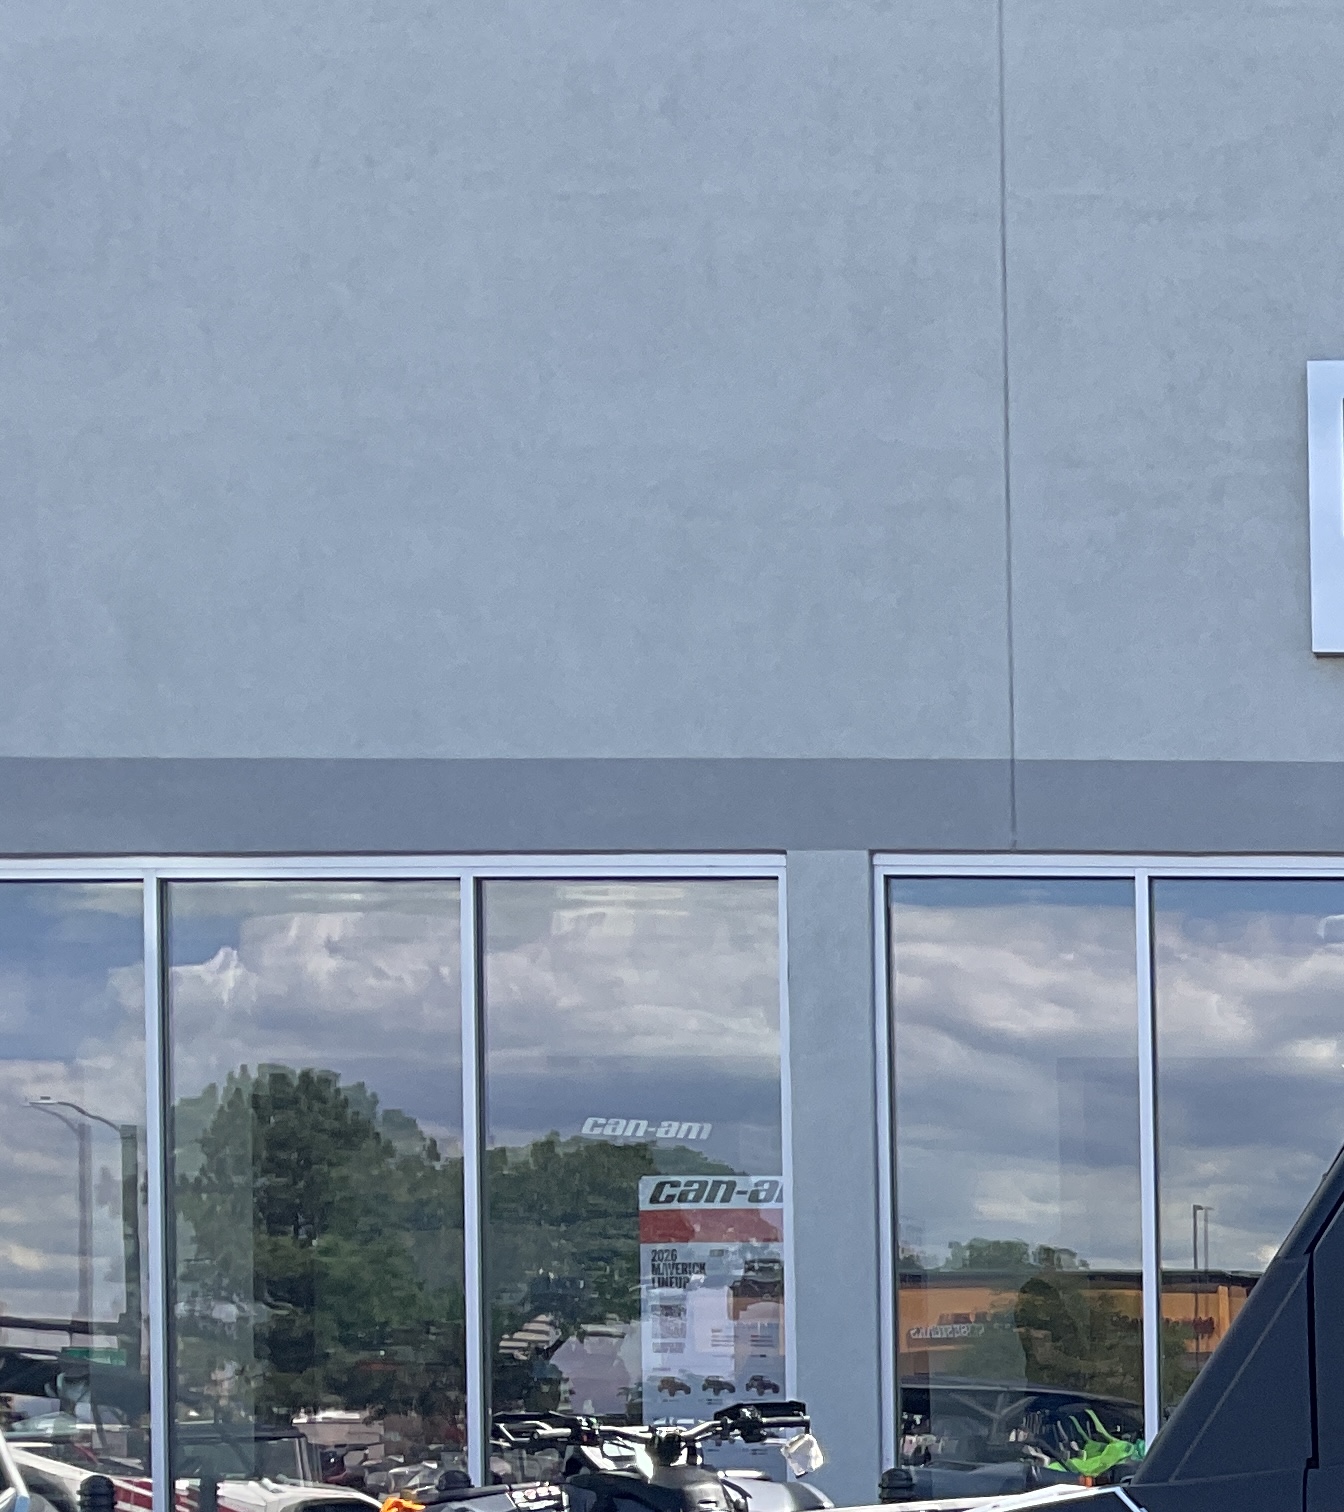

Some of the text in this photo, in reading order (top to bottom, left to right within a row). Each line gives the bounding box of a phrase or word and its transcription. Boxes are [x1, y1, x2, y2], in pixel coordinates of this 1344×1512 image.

[581, 1116, 712, 1140] can-am
[651, 1248, 677, 1262] 2026
[651, 1262, 706, 1276] MAVERICK
